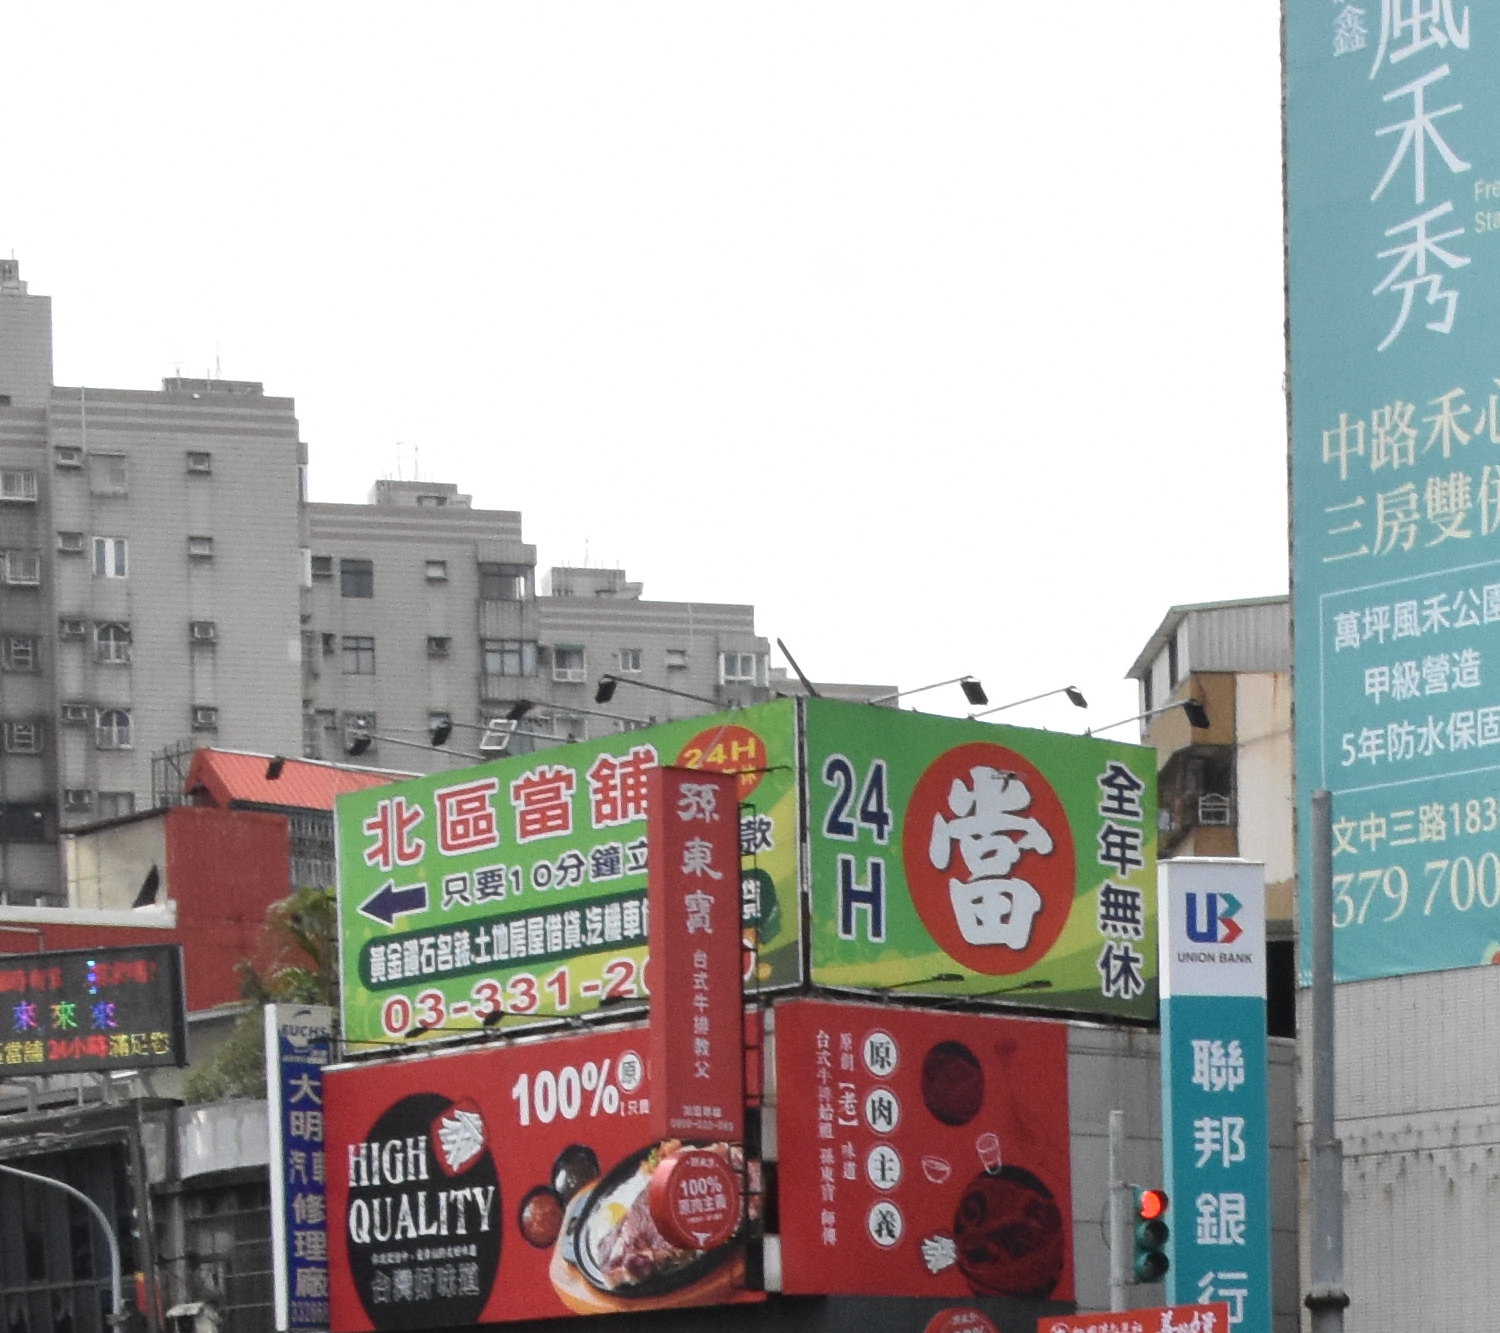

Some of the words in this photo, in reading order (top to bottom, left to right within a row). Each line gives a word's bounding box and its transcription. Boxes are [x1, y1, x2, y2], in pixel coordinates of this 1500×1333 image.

[1370, 0, 1471, 352] 風禾秀
[1364, 650, 1481, 705] 甲級營造
[684, 738, 757, 769] 24H
[822, 753, 893, 847] 24
[363, 743, 658, 872] 北區當舖
[677, 782, 723, 935] 孫東寶
[927, 763, 1056, 953] 當
[1097, 761, 1147, 1001] 全年無休
[1333, 864, 1409, 928] 379
[1177, 952, 1217, 965] UNION
[1219, 951, 1254, 965] BANK
[511, 1058, 620, 1127] 100%
[868, 1038, 898, 1241] 原肉主義
[348, 1134, 429, 1188] HIGH
[1190, 1037, 1249, 1325] 聯邦銀行
[349, 1185, 496, 1245] QUALITY
